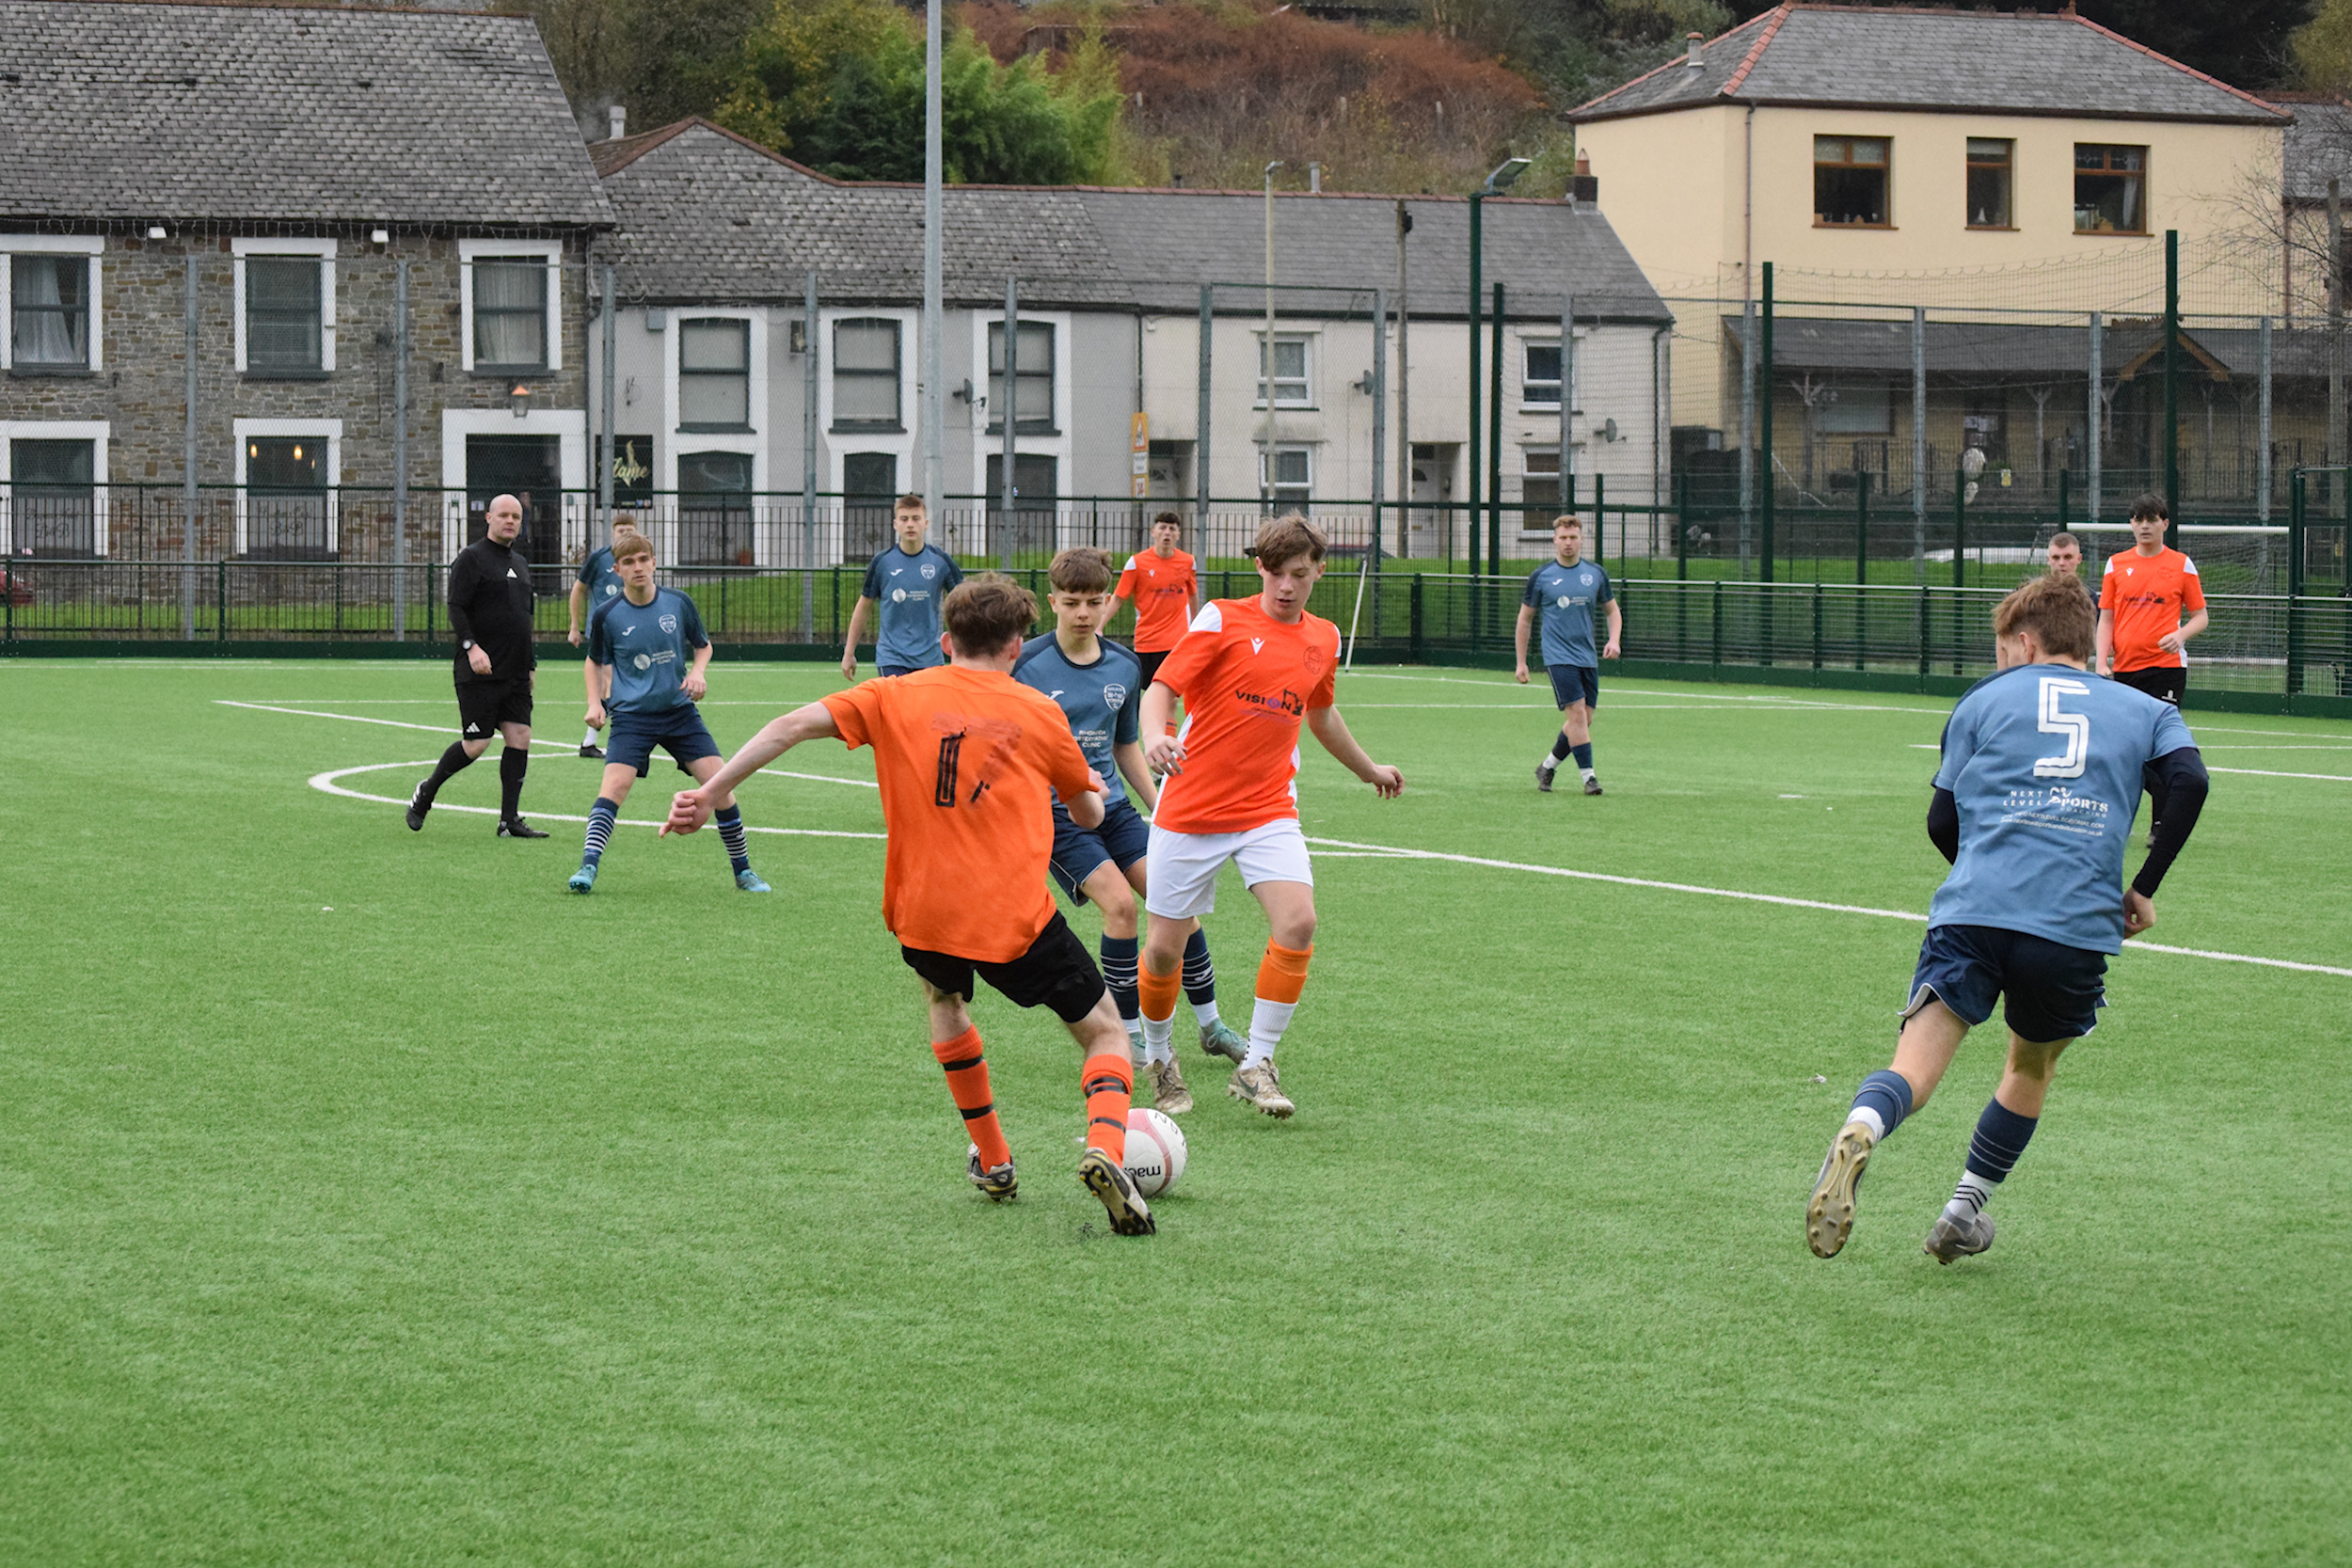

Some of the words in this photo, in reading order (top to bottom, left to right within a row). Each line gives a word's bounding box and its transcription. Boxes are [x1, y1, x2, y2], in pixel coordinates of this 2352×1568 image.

[1235, 689, 1292, 711] VISION
[2033, 677, 2090, 778] 5
[2059, 806, 2107, 818] COACHING
